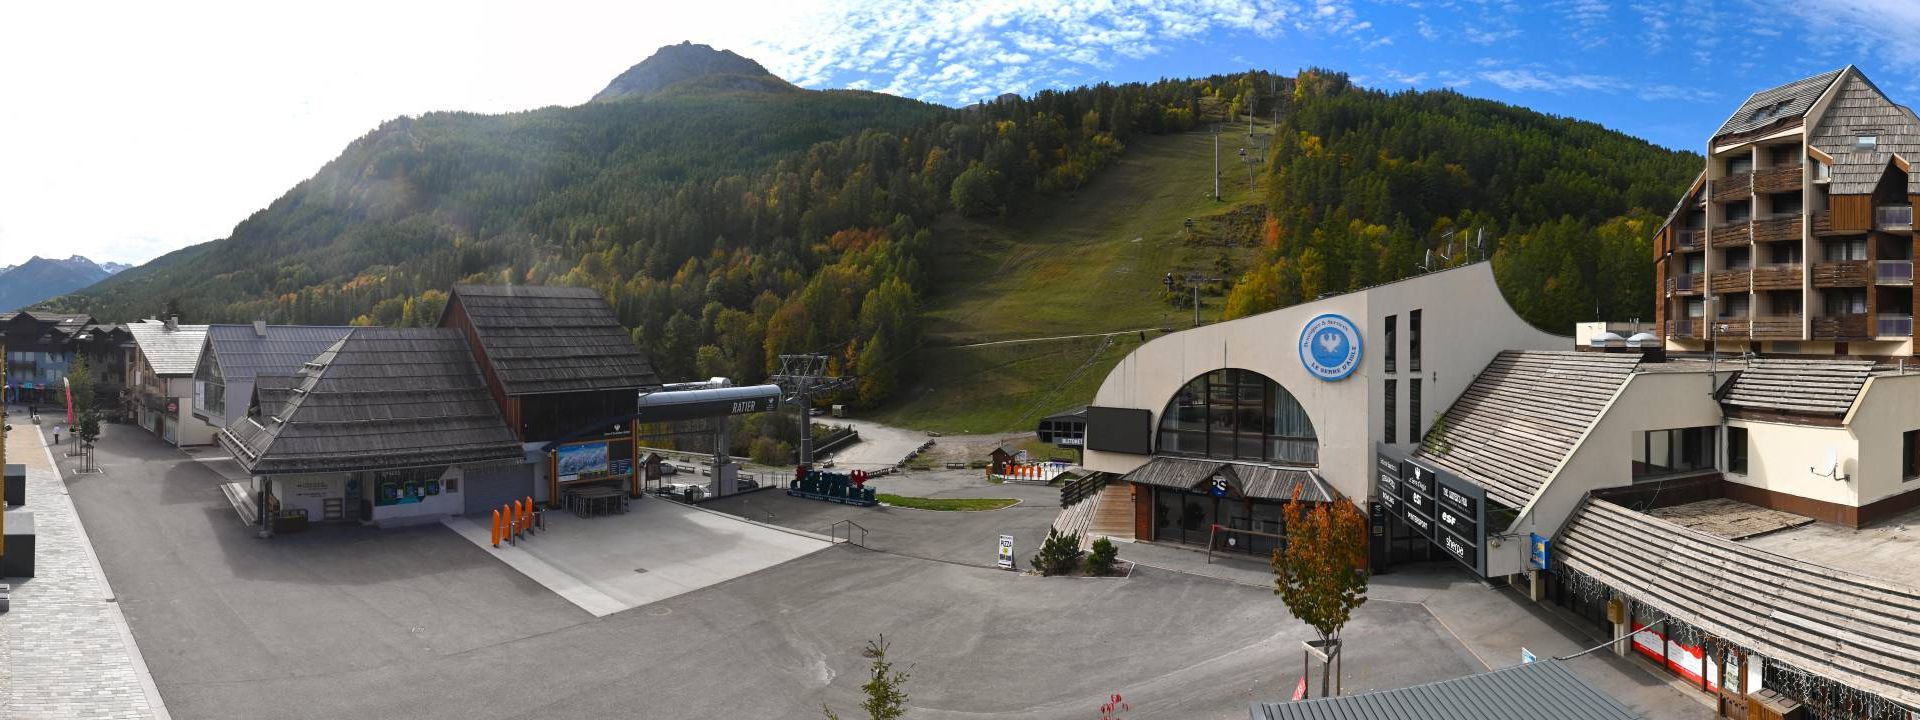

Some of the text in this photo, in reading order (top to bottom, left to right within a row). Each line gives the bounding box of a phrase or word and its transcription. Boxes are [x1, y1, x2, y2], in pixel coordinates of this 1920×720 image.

[1311, 361, 1320, 371] LE
[731, 400, 756, 413] RATIER
[1445, 535, 1464, 556] sherpa
